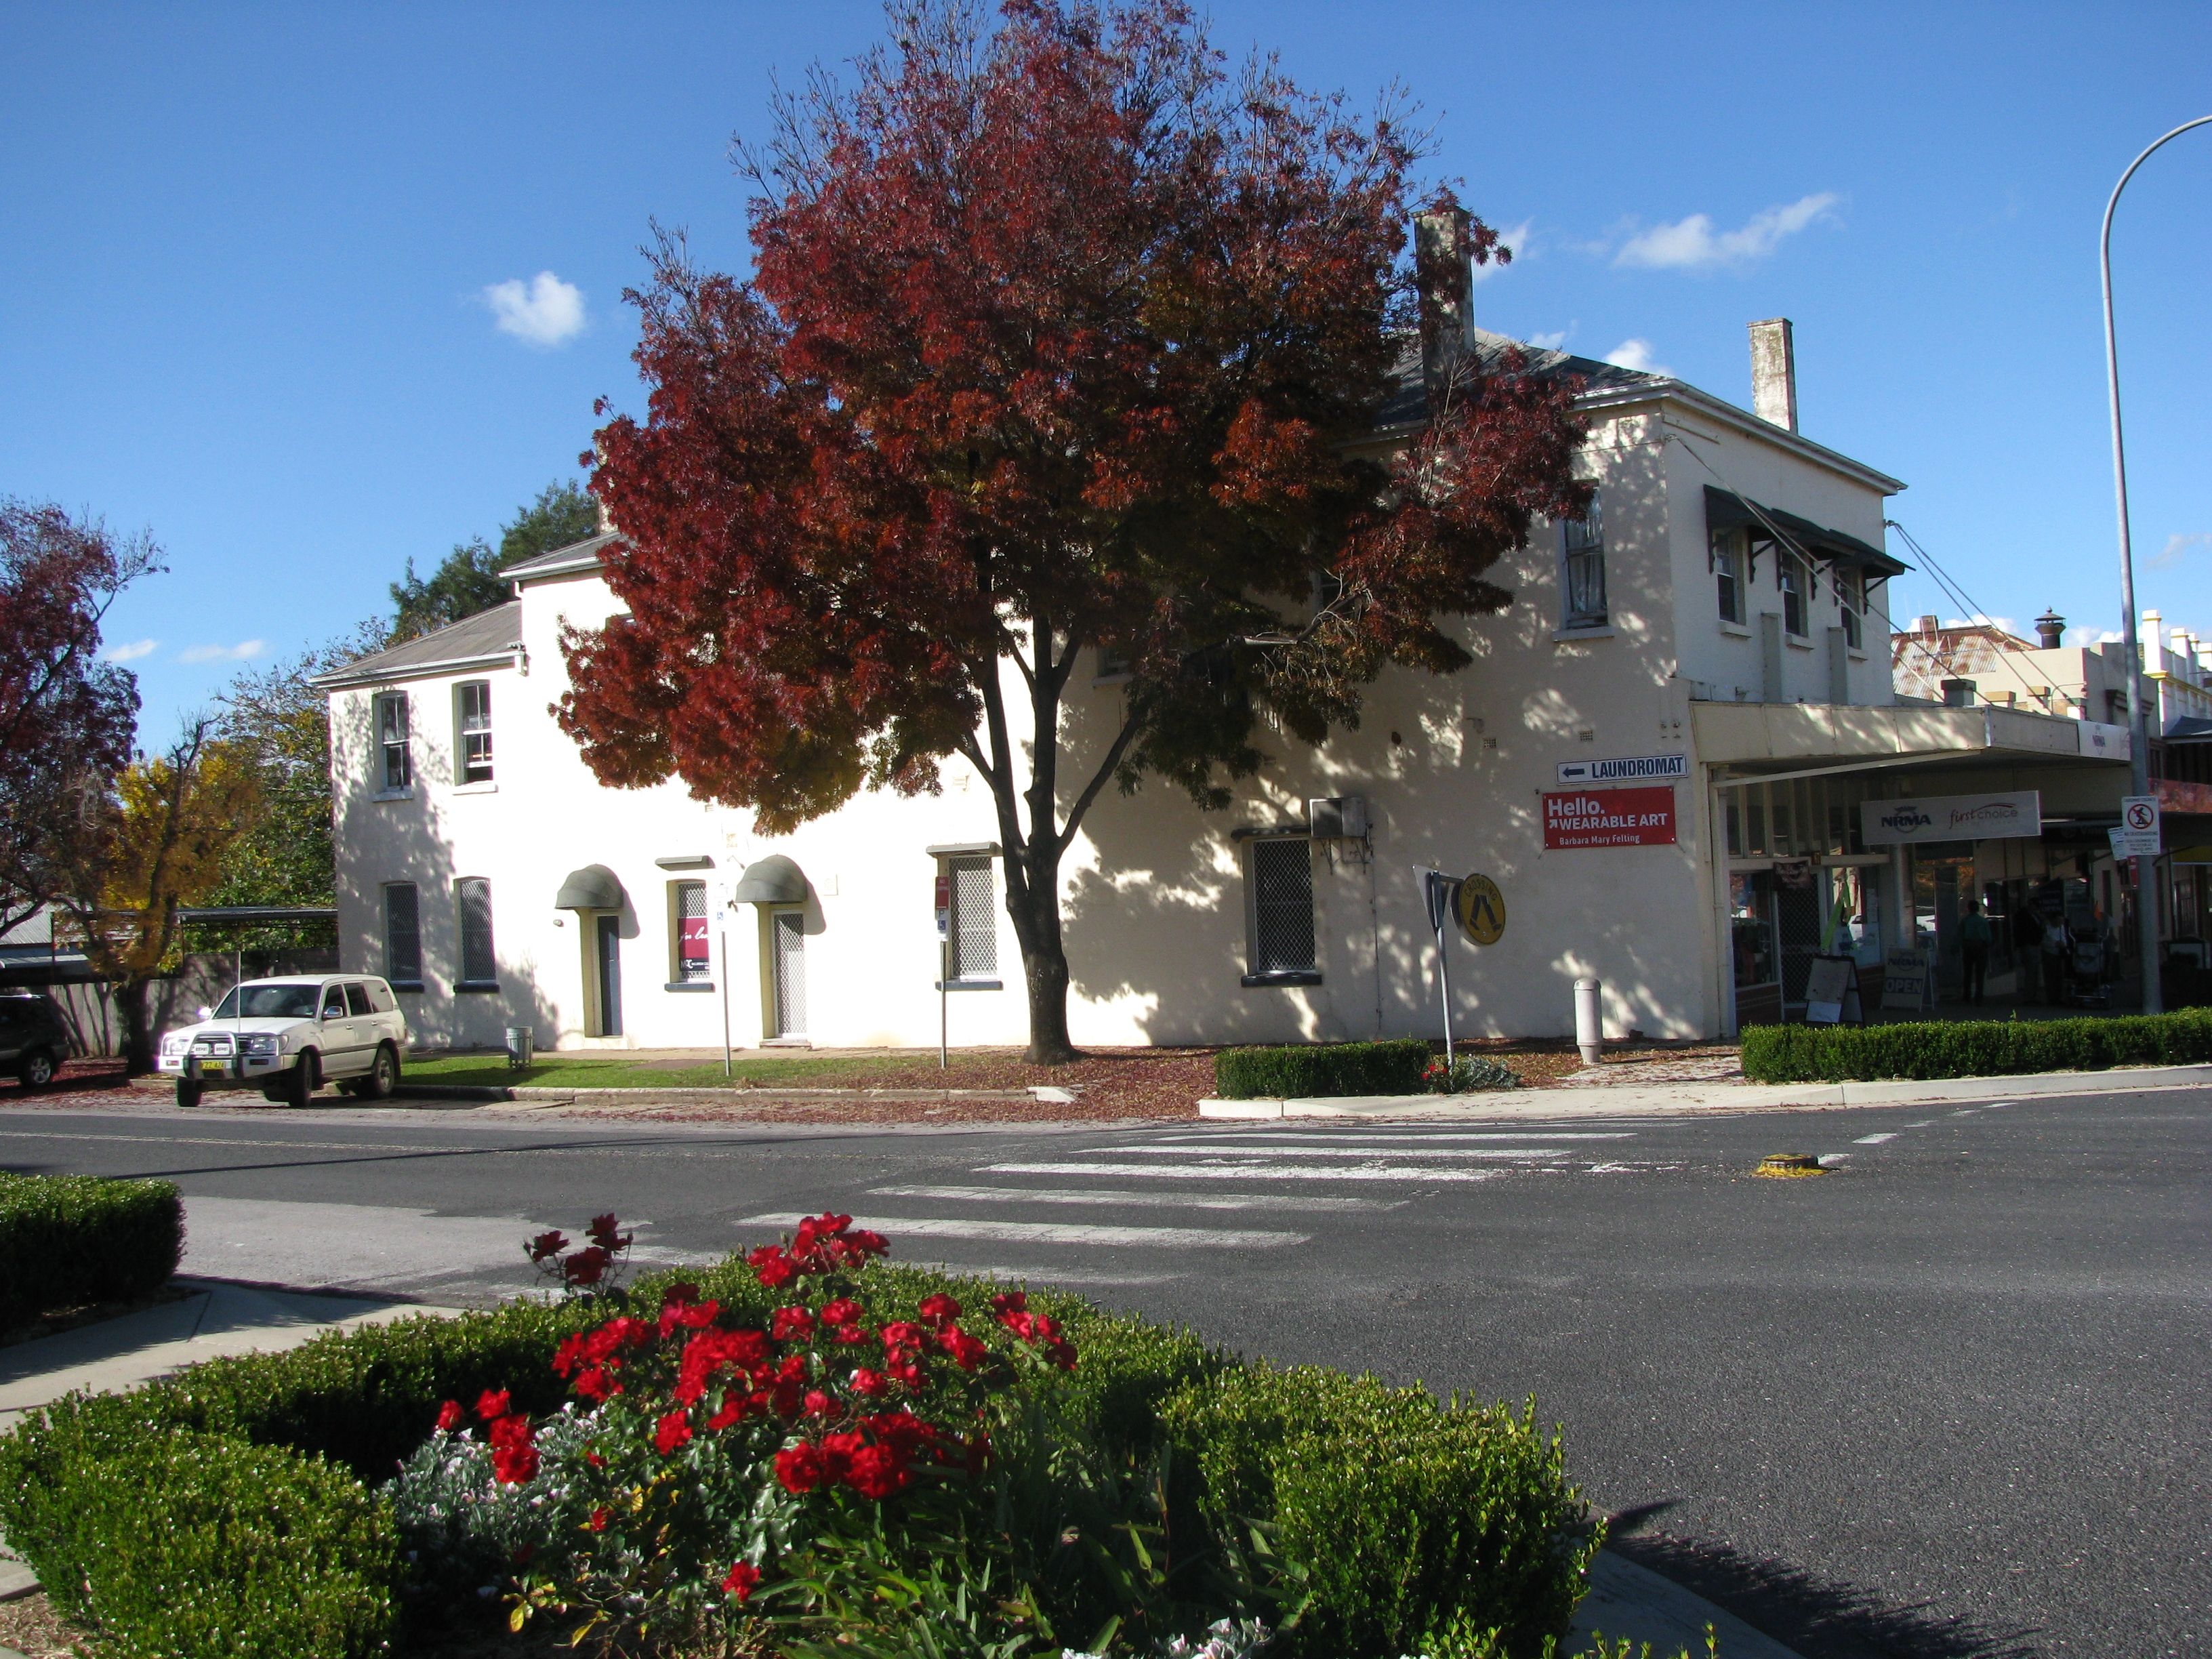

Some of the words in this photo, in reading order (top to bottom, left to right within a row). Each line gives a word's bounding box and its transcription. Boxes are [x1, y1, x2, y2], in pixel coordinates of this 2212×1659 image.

[1592, 756, 1683, 779] LAUNDROMAT
[1548, 797, 1605, 817] Hello.
[1559, 815, 1635, 830] WEARABLE
[1639, 813, 1668, 827] ART
[1881, 815, 1931, 827] NRMA
[1948, 808, 1975, 830] first
[1977, 809, 2018, 820] choice
[1559, 836, 1589, 846] Barbara
[1591, 836, 1610, 845] Mary
[1612, 834, 1640, 844] Felting
[1464, 878, 1498, 901] CROSSING
[1886, 979, 1923, 994] OPEN
